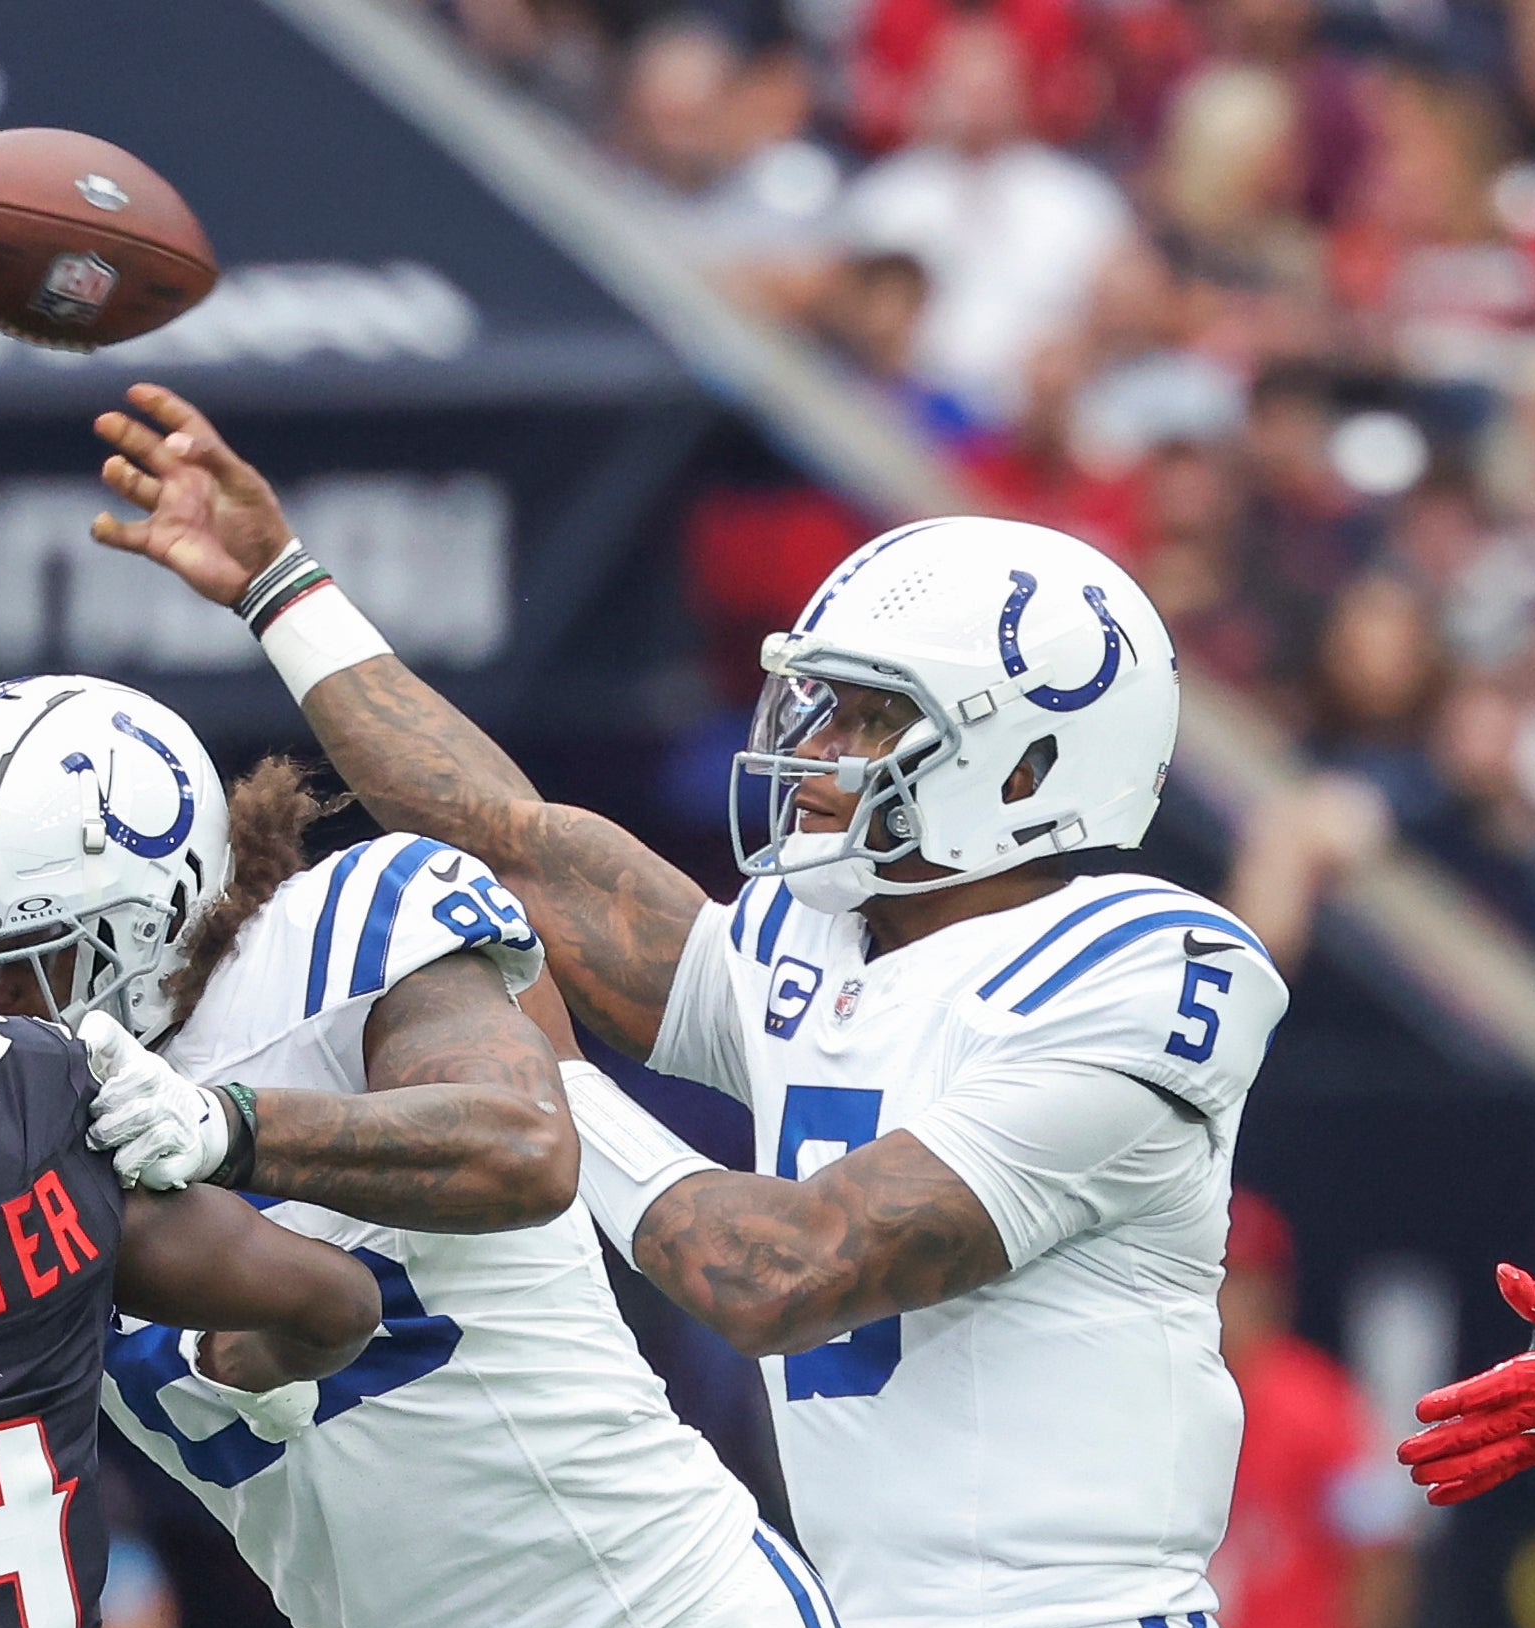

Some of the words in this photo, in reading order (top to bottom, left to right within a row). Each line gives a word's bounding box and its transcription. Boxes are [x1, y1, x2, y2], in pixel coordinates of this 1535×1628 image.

[10, 906, 64, 923] OAKLEY
[769, 961, 817, 1019] C
[1164, 960, 1233, 1065] 5
